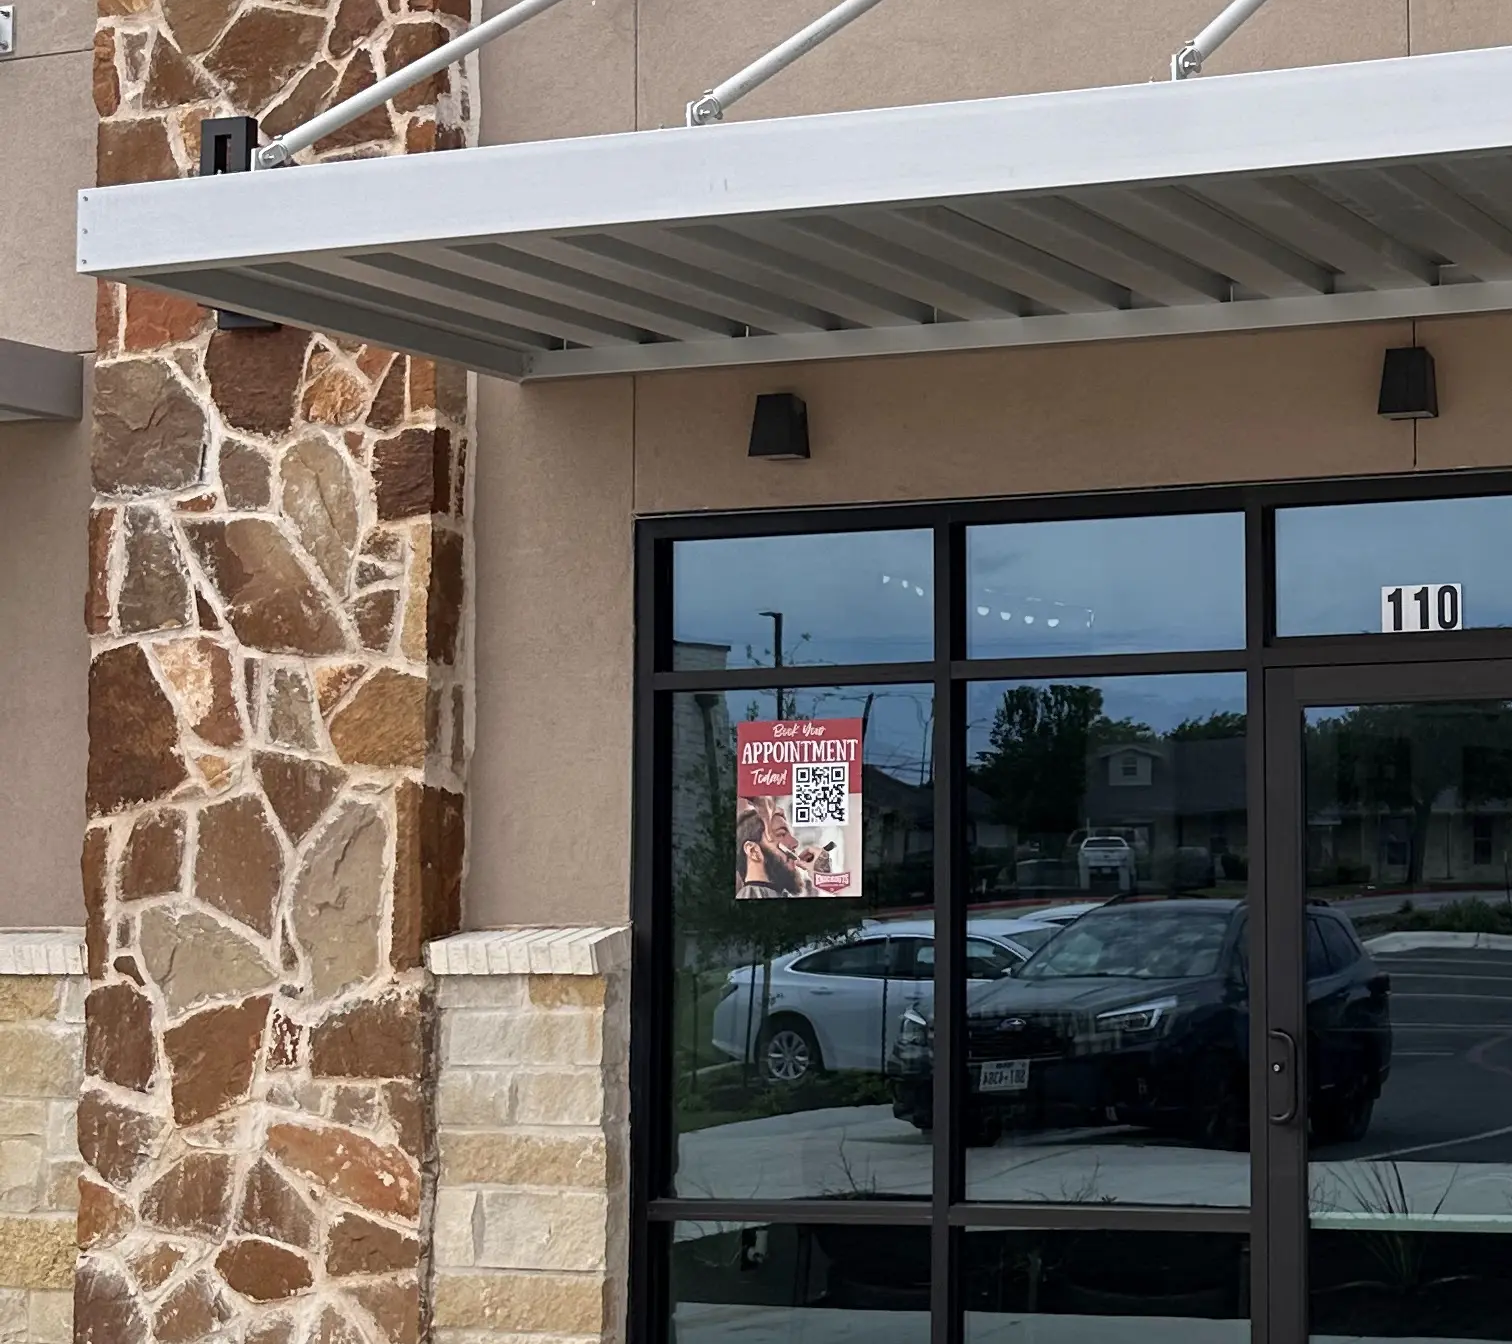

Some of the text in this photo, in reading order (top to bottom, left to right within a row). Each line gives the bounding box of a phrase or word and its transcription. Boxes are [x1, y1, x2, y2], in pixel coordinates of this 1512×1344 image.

[1388, 585, 1458, 631] 110
[741, 739, 859, 764] APPOINTMENT
[750, 768, 788, 786] Today!
